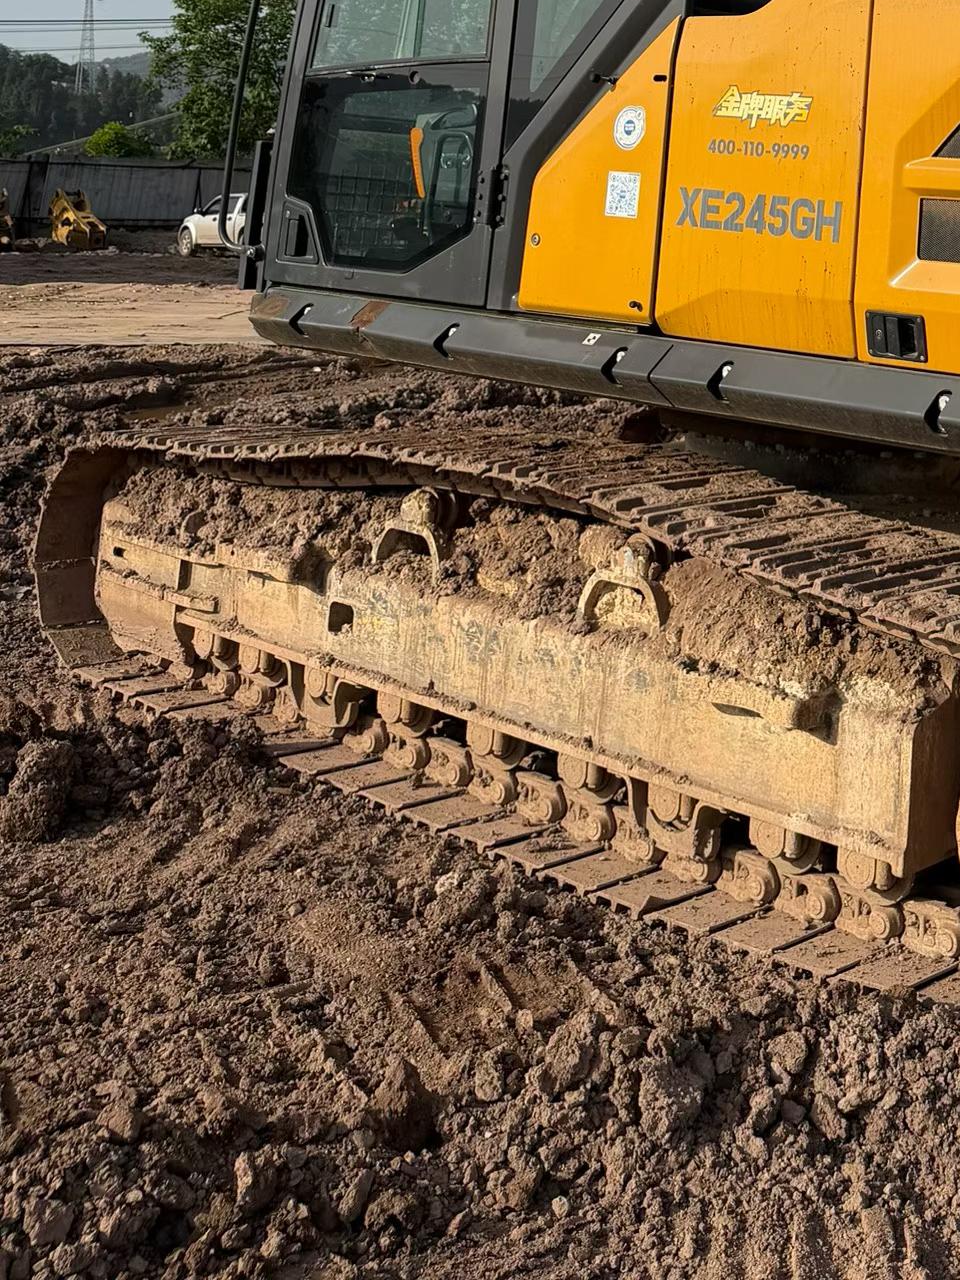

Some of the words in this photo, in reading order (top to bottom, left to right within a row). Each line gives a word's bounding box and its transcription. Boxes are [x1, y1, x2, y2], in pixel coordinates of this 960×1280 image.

[713, 85, 813, 128] 金牌服务
[708, 139, 810, 160] 400-110-9999
[676, 186, 843, 244] XE245GH
